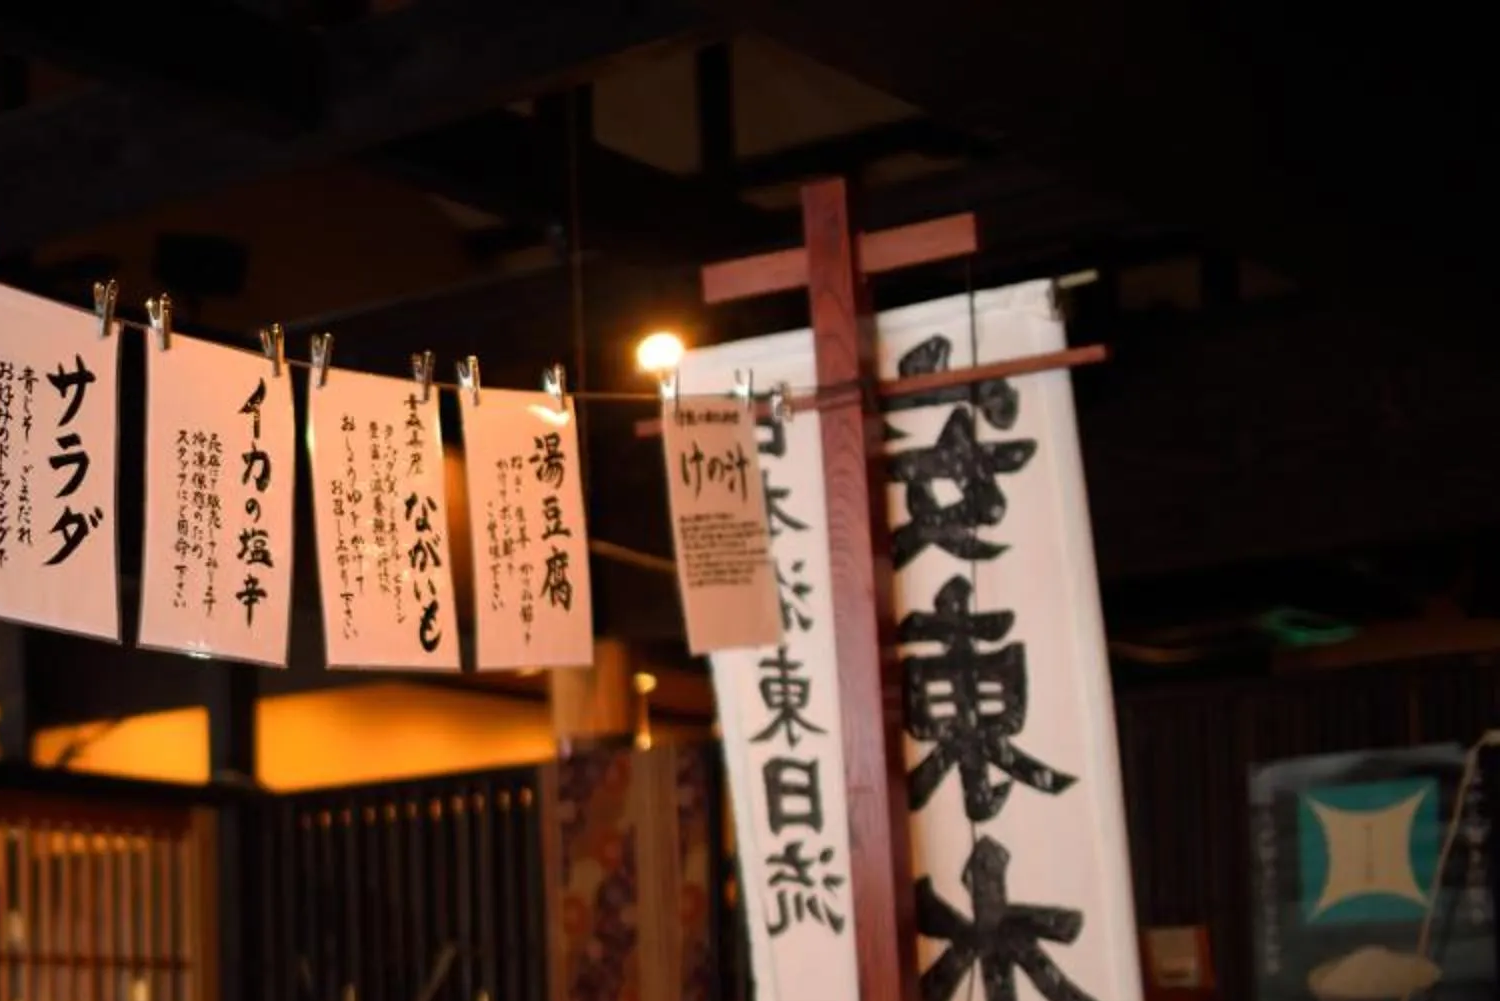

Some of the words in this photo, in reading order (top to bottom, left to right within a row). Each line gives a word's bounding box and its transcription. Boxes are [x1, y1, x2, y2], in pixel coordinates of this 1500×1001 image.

[42, 353, 104, 566] サラダ
[235, 377, 274, 628] イカの塩辛
[528, 432, 573, 612] 湯豆腐
[680, 441, 749, 501] けの汁
[404, 491, 442, 653] ながいも
